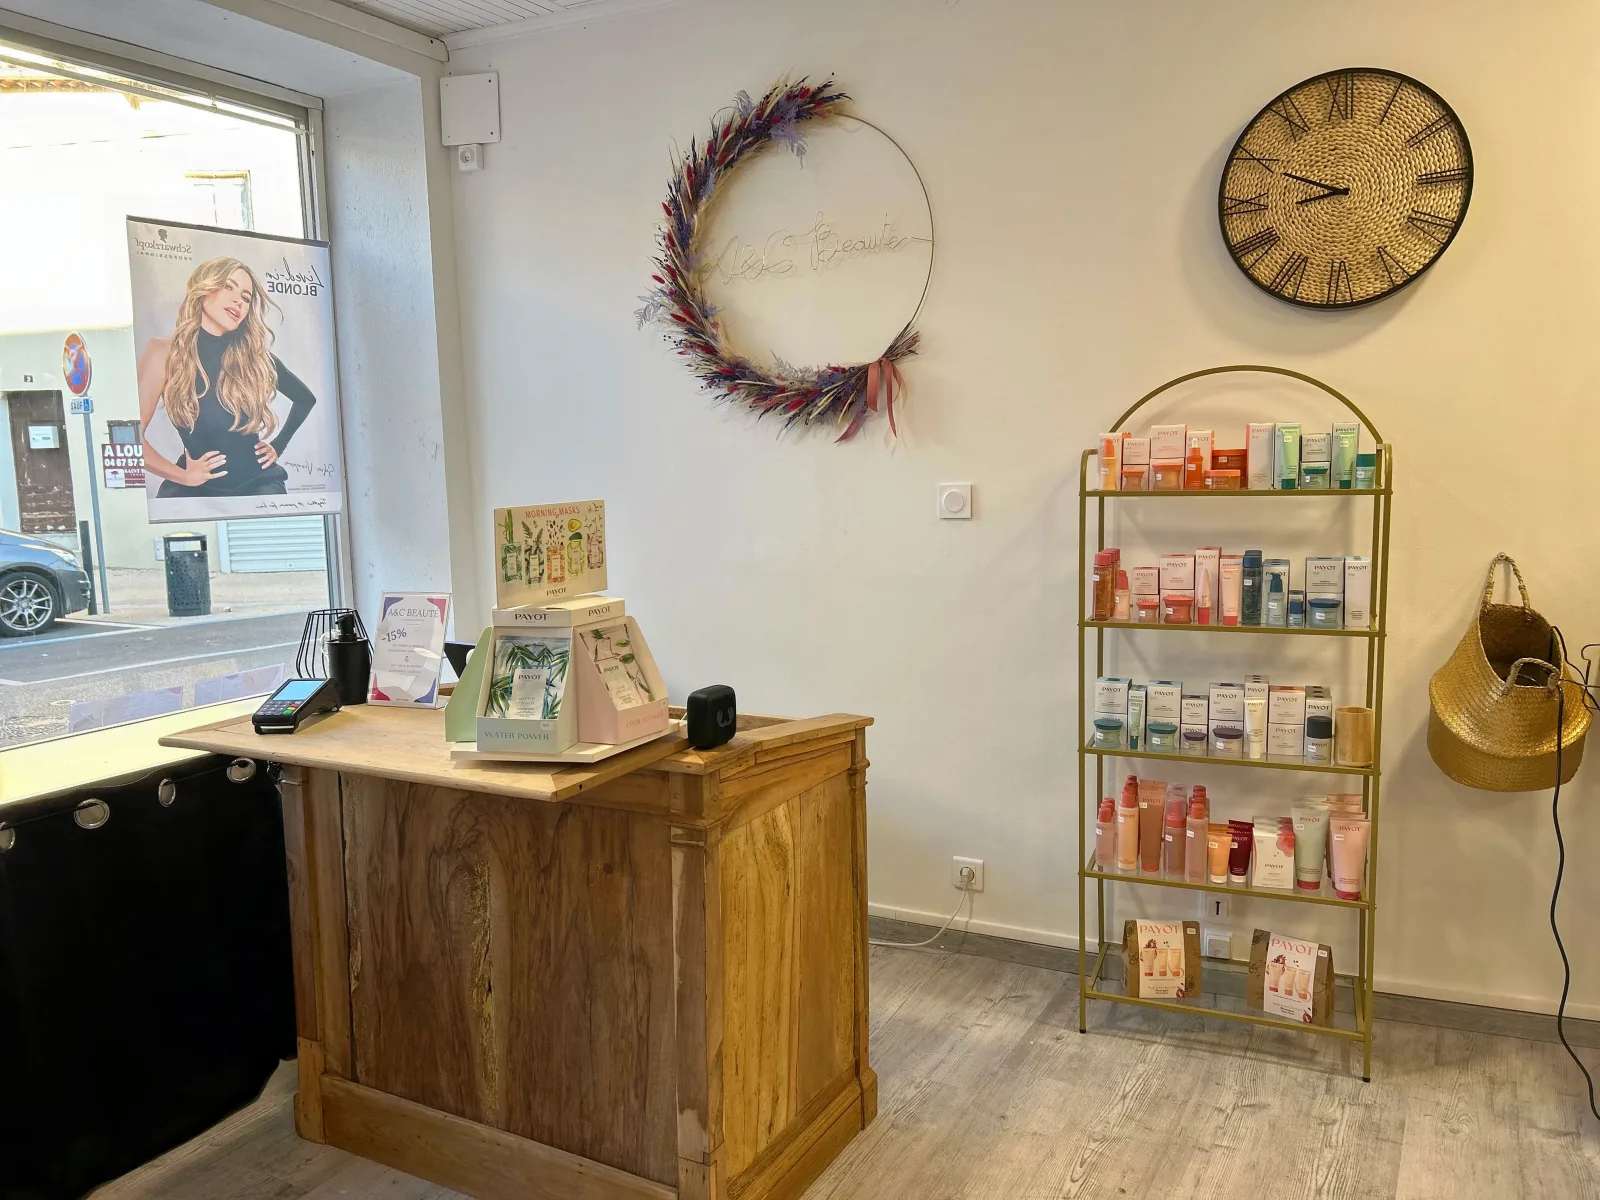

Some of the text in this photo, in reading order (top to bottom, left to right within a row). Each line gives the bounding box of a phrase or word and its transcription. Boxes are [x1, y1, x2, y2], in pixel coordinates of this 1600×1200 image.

[70, 401, 82, 410] SAUF
[104, 444, 114, 457] A
[104, 458, 115, 466] 04
[116, 458, 126, 466] 67
[128, 458, 138, 466] 57
[525, 506, 580, 518] MORNING MASKS
[546, 587, 568, 596] PAYOT
[388, 608, 406, 617] A&C
[588, 606, 611, 616] PAYOT
[382, 628, 407, 642] -15%
[604, 665, 619, 673] PAYOT
[484, 731, 549, 741] WATER POWER
[1140, 925, 1179, 934] PAYOT
[1271, 938, 1316, 955] PAYOT
